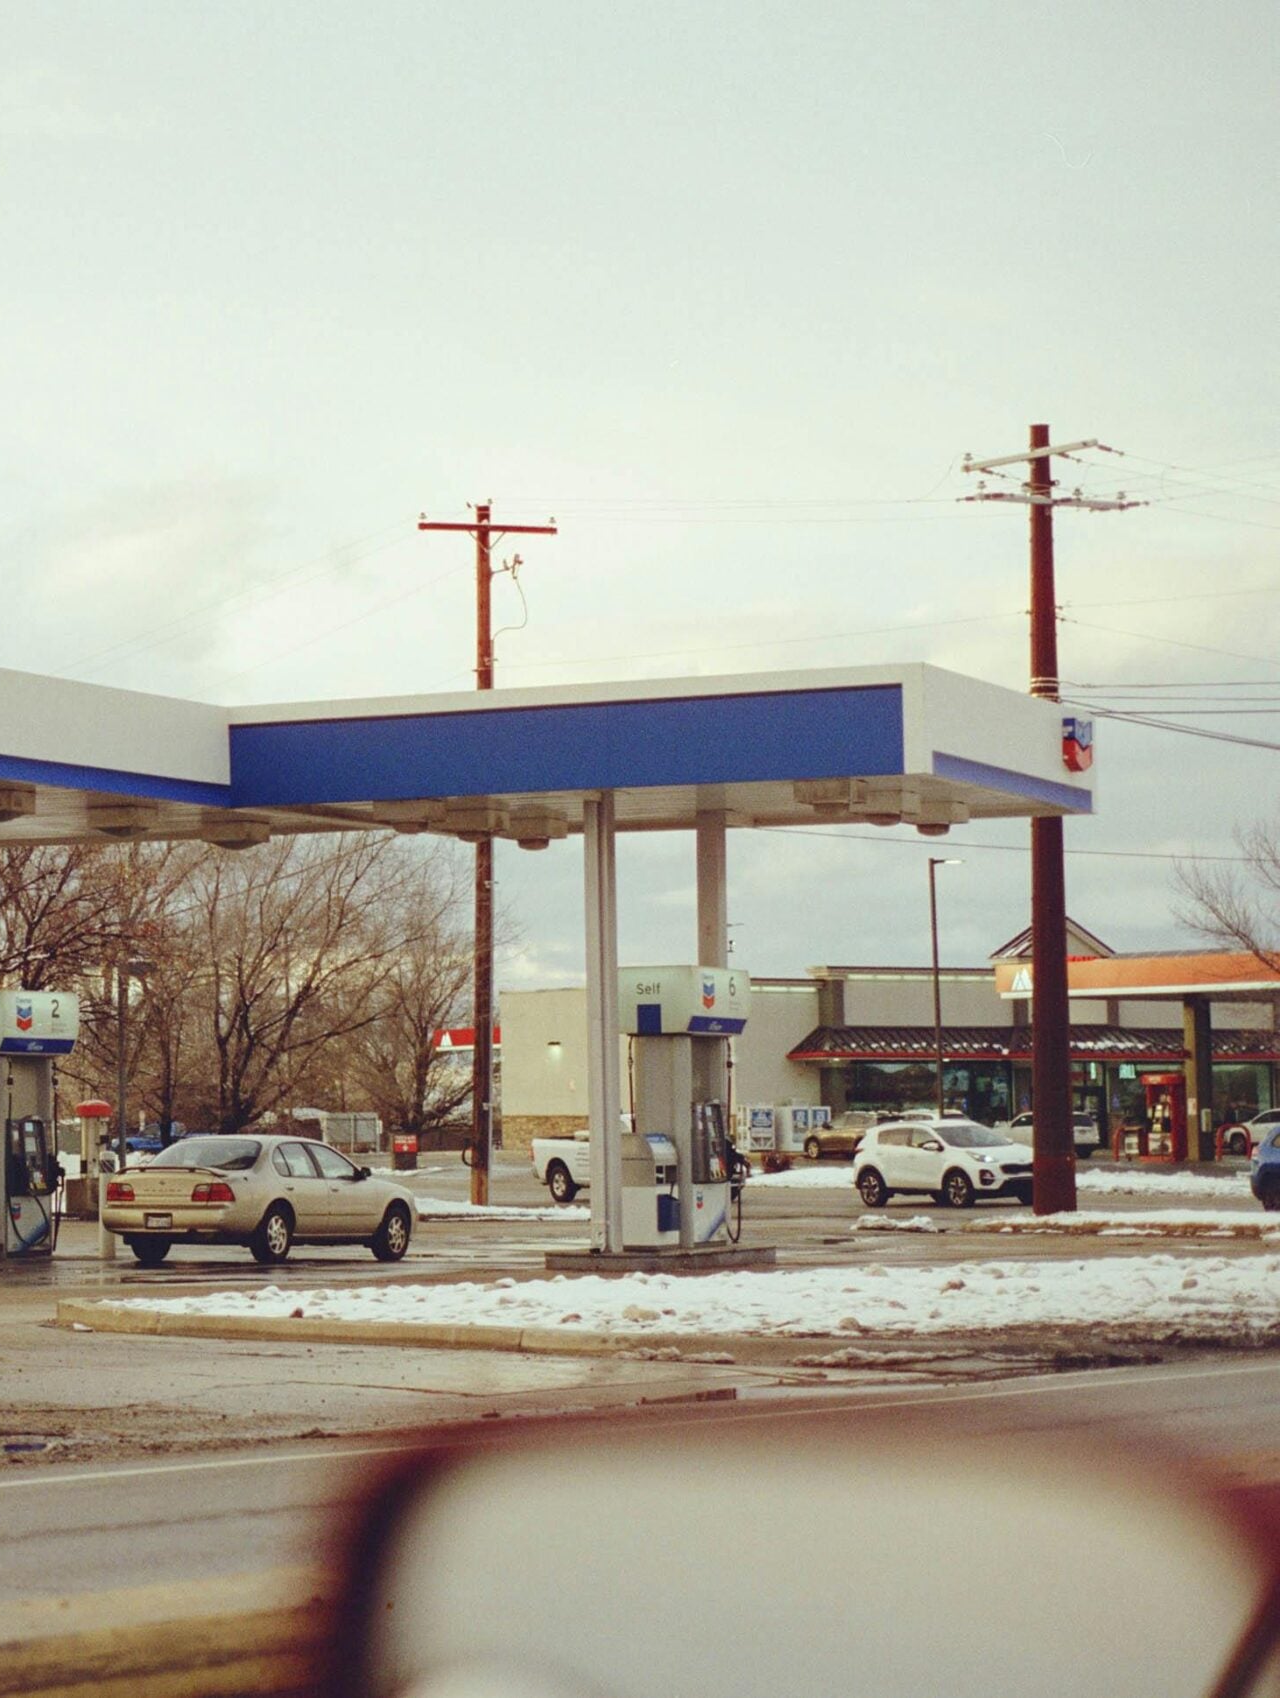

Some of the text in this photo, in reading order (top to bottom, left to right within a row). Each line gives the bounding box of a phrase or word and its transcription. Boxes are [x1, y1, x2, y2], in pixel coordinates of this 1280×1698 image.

[636, 982, 661, 995] Self
[728, 976, 736, 996] 6
[51, 999, 60, 1018] 2
